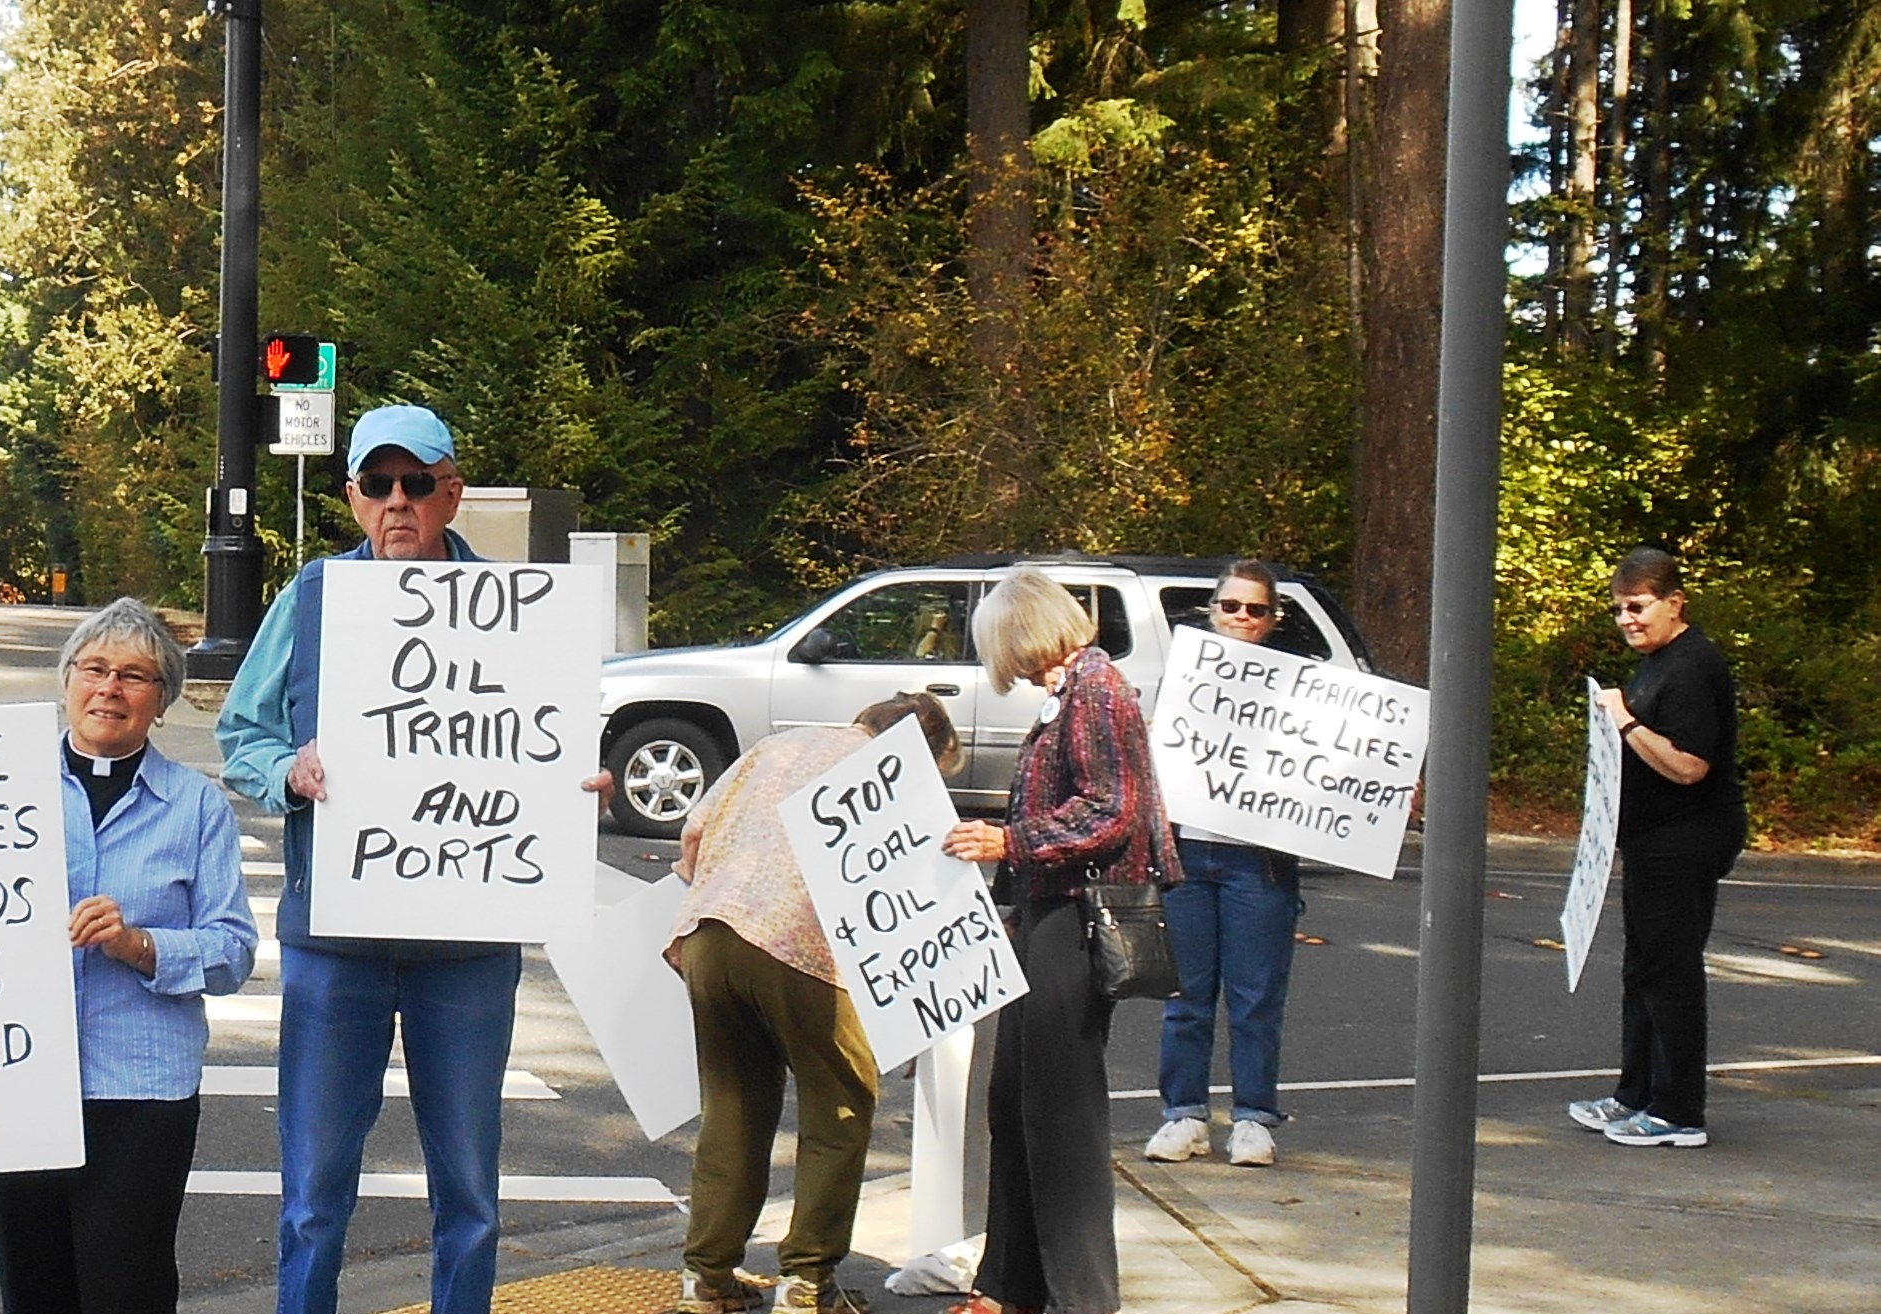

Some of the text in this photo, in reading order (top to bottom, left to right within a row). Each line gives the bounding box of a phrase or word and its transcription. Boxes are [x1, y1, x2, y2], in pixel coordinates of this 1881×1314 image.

[285, 416, 320, 428] MOTOR
[295, 399, 310, 411] NO
[393, 567, 554, 632] STOP
[392, 637, 506, 694] OIL
[1195, 639, 1281, 691] POPE
[362, 697, 563, 764] TRAINS
[1265, 749, 1296, 778] TO
[412, 781, 520, 828] AND
[811, 754, 902, 849] STOP
[351, 827, 545, 885] PORTS
[841, 823, 932, 884] COAL
[866, 889, 937, 933] OIL
